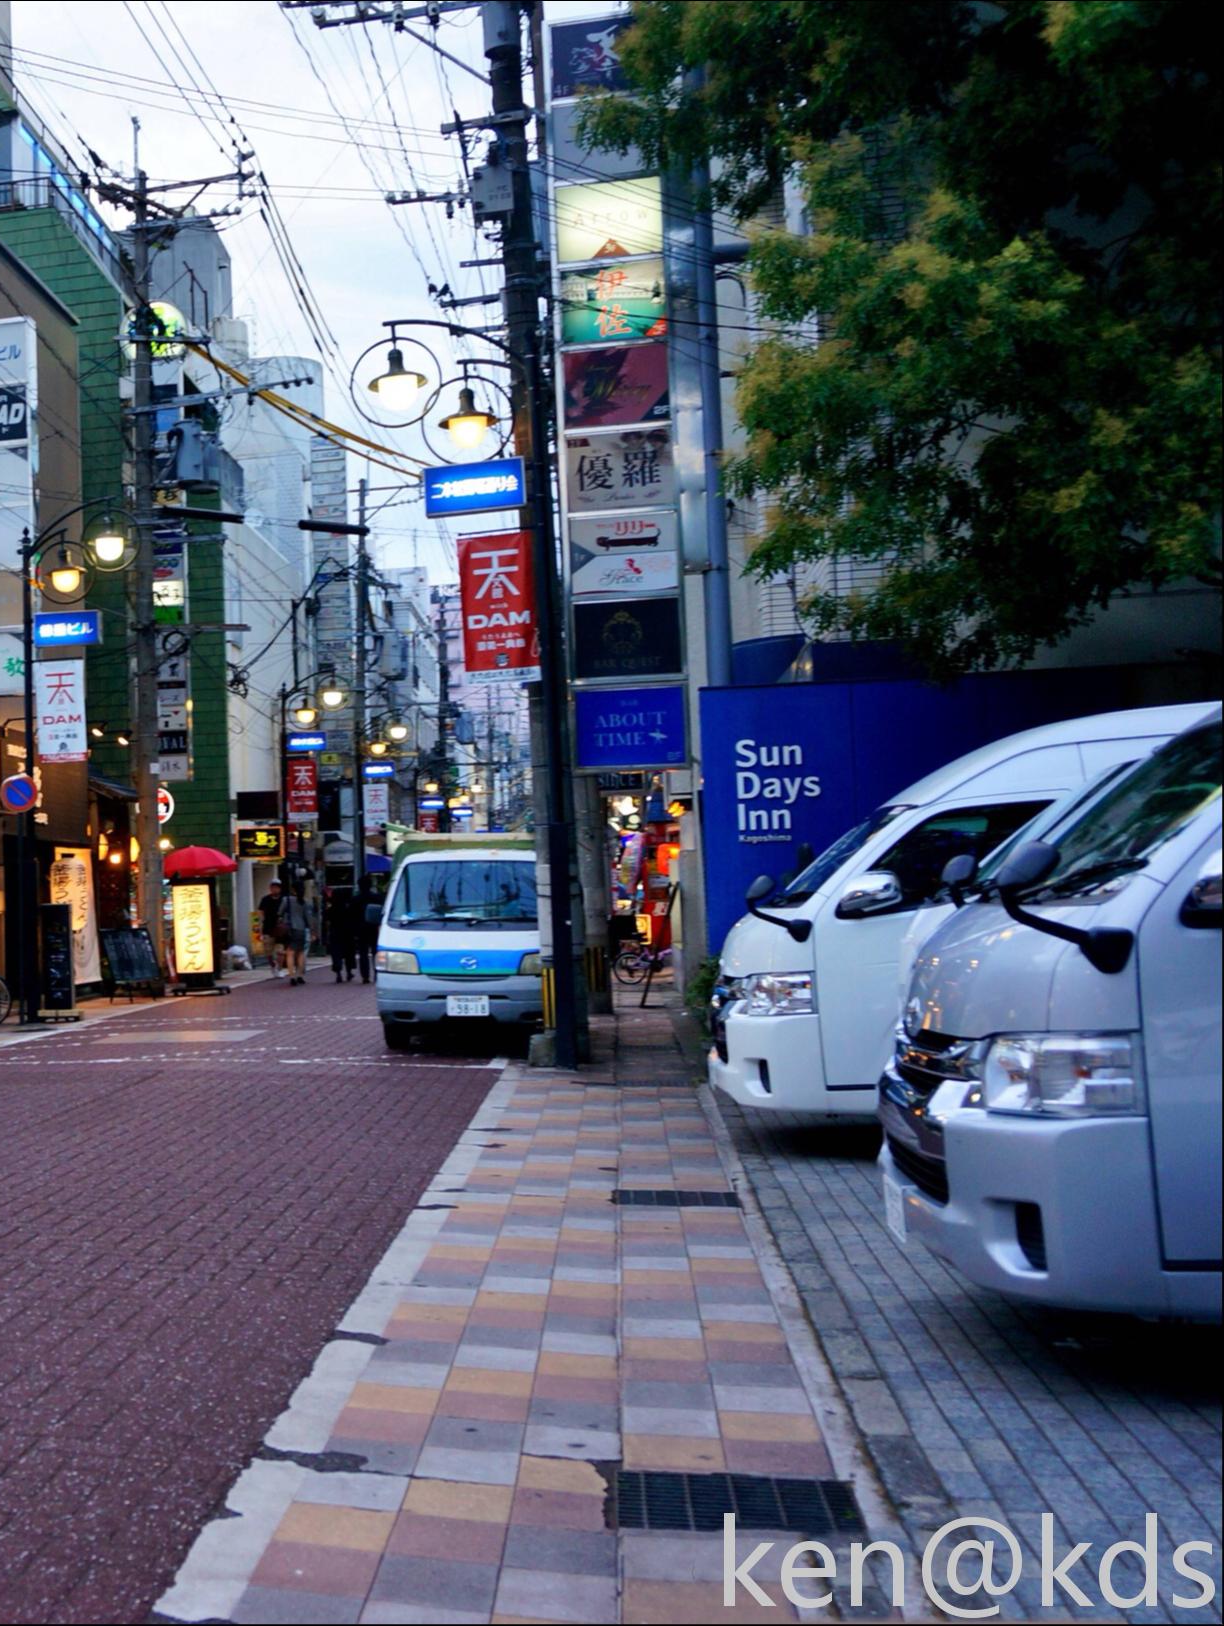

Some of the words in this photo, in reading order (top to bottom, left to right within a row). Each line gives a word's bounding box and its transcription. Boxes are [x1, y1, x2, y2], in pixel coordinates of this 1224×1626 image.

[595, 268, 633, 337] 伊佐
[576, 451, 662, 492] 優羅
[467, 610, 531, 630] DAM
[42, 714, 82, 726] DAM
[594, 711, 667, 729] ABOUT
[593, 731, 646, 748] TIME
[735, 739, 802, 768] Sun
[736, 771, 822, 804] Days
[737, 803, 791, 831] Inn
